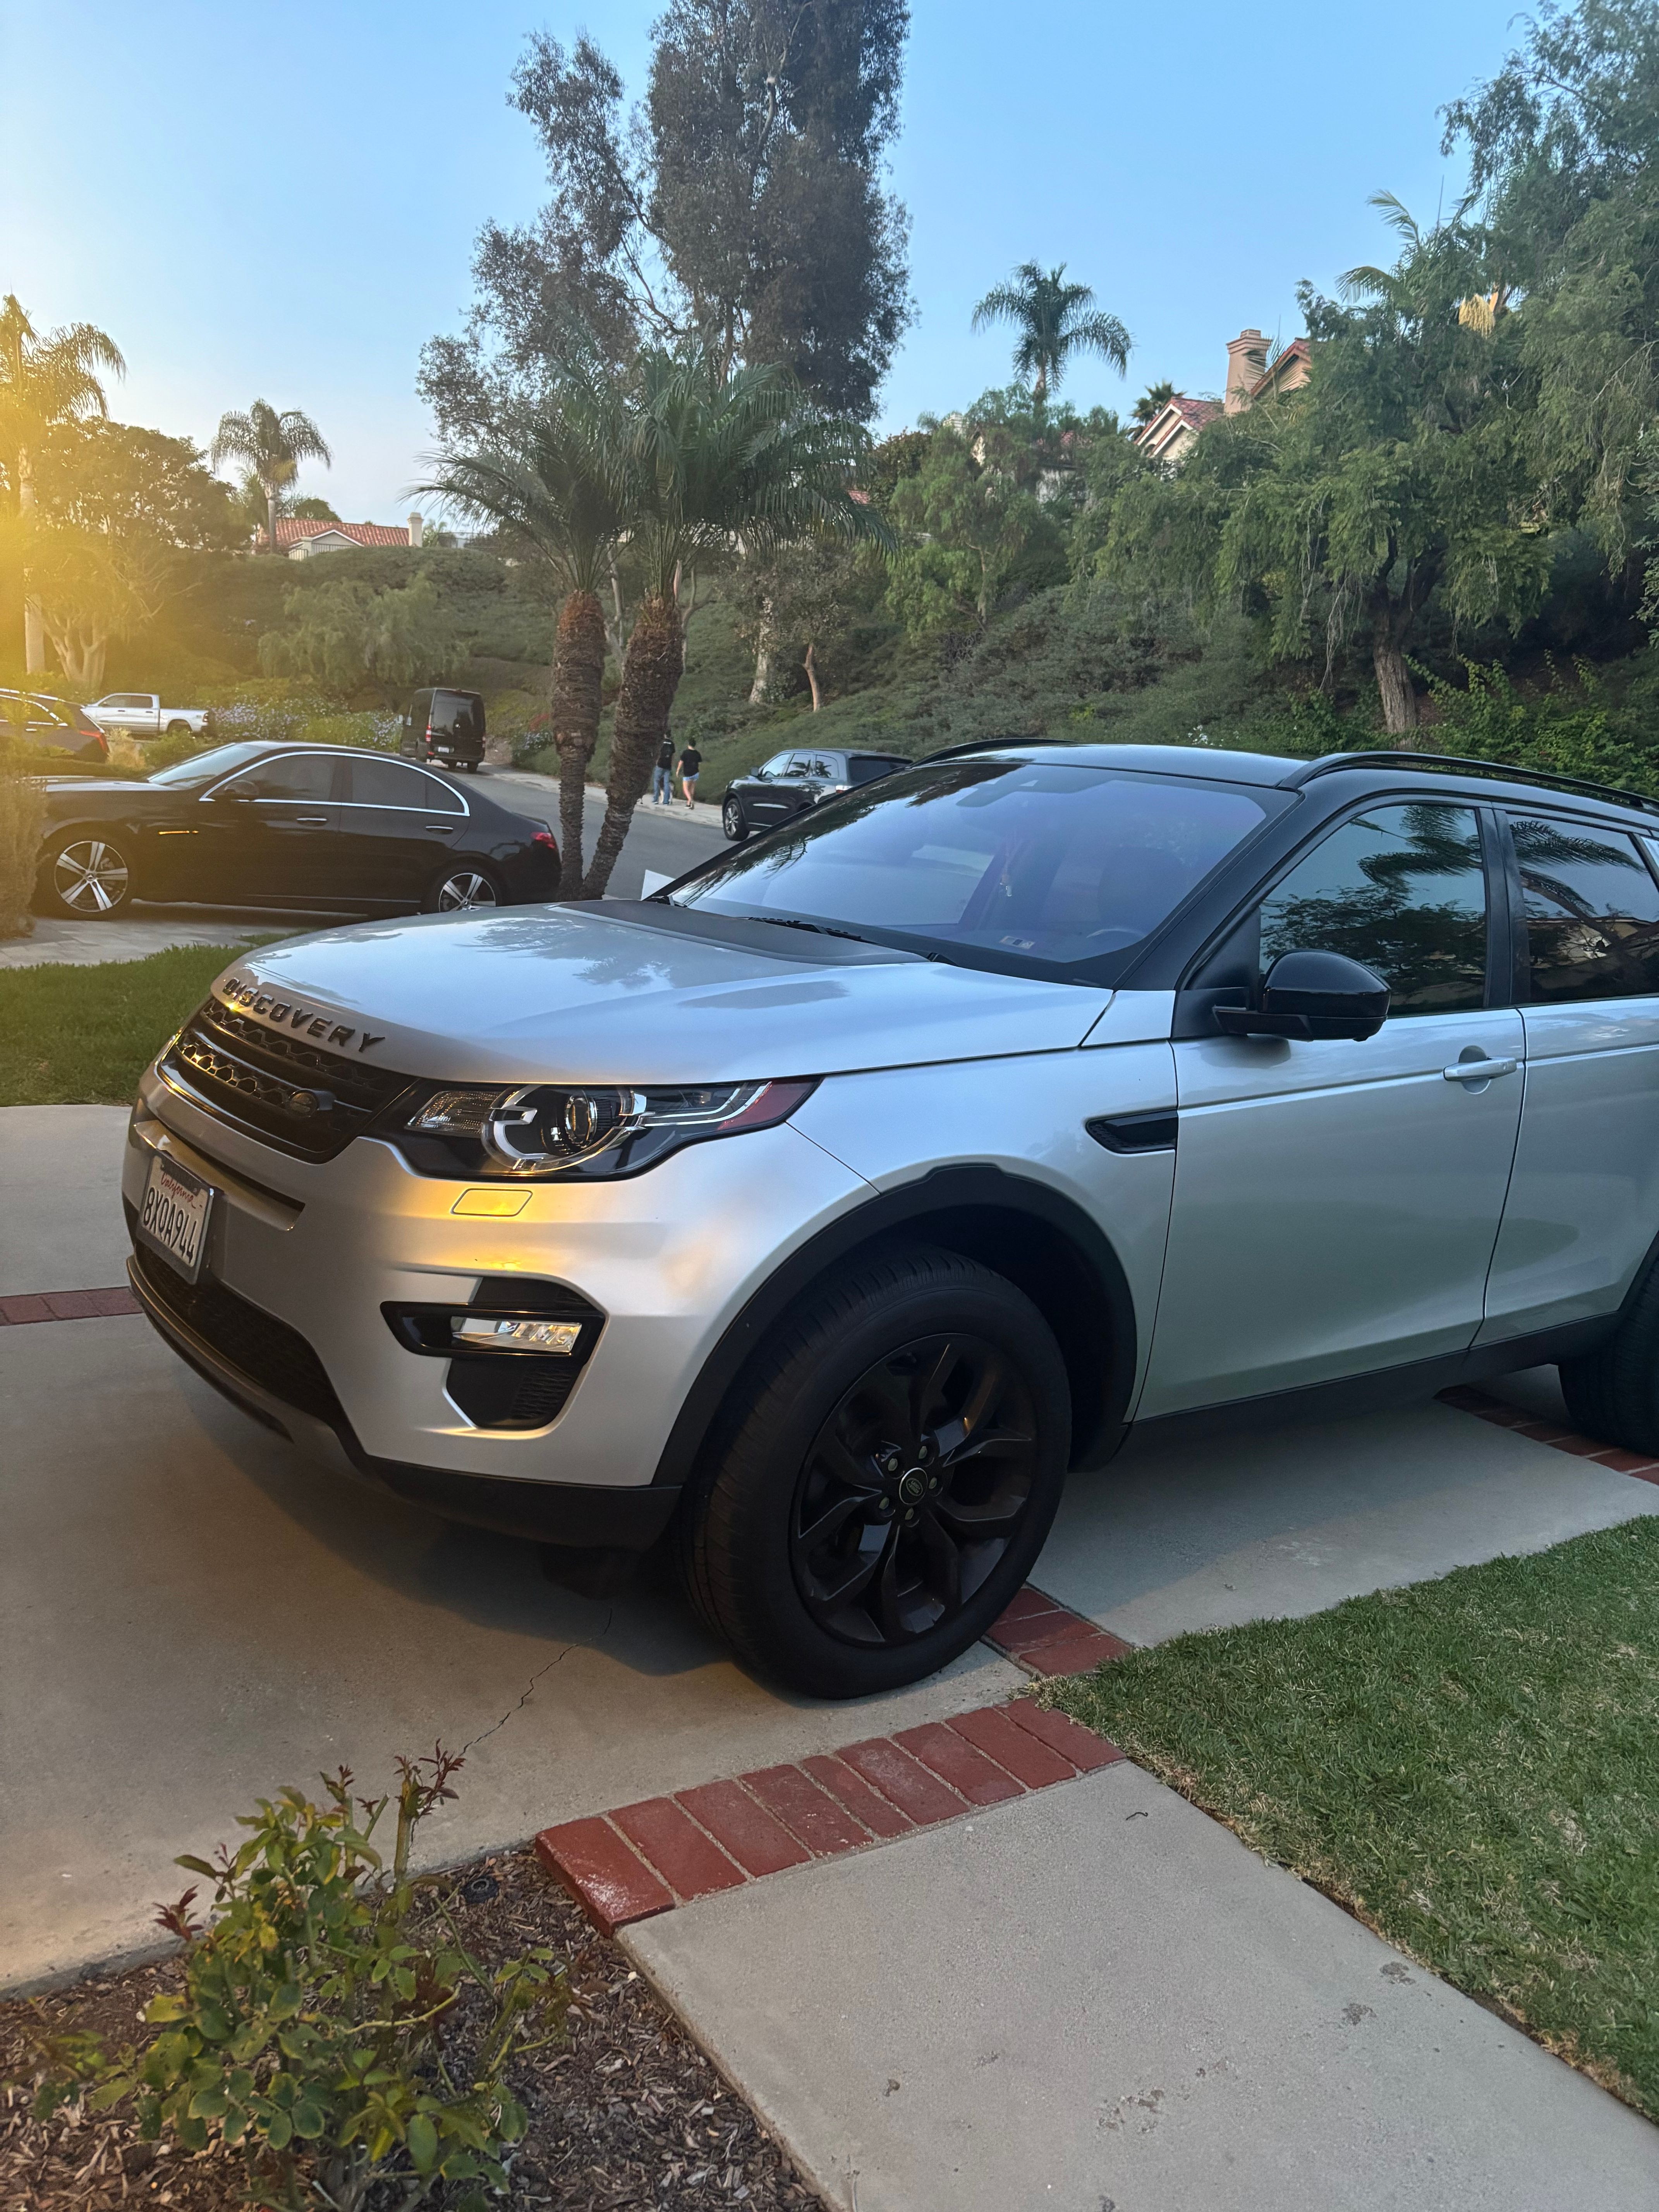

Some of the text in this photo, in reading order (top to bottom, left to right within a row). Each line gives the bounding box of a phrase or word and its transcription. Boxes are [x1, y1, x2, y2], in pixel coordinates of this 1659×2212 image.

[223, 977, 385, 1053] DISCOVERY
[144, 1187, 197, 1264] 8XQA944
[161, 1172, 196, 1209] California
